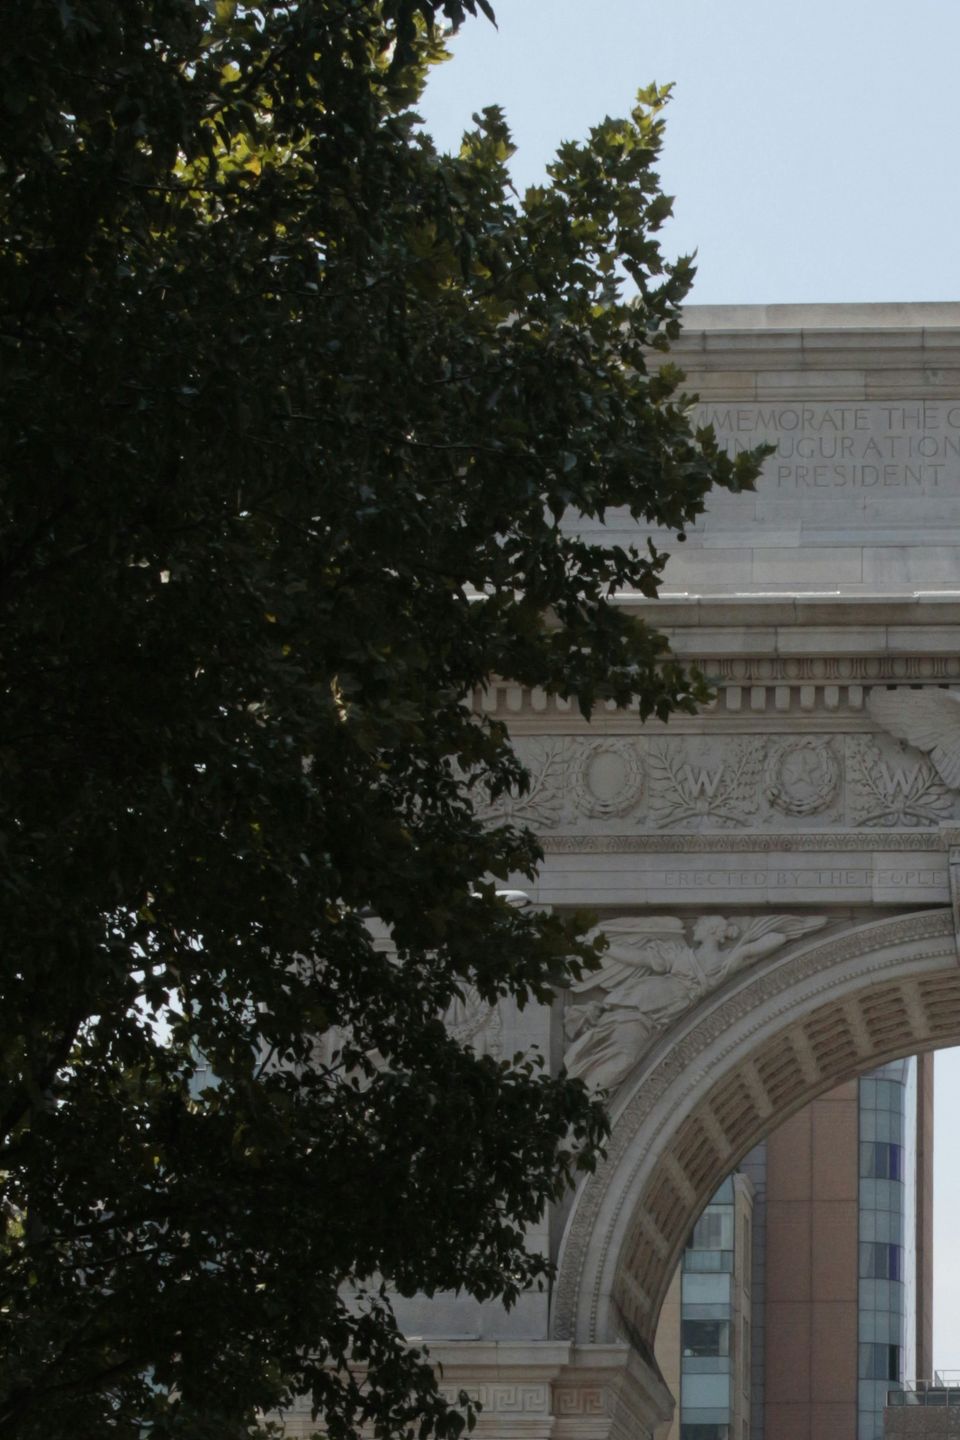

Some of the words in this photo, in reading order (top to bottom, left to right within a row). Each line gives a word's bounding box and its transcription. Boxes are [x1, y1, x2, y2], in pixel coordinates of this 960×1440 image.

[880, 406, 940, 430] THE
[723, 435, 960, 460] INUGURATION
[776, 463, 946, 488] PRESIDENT
